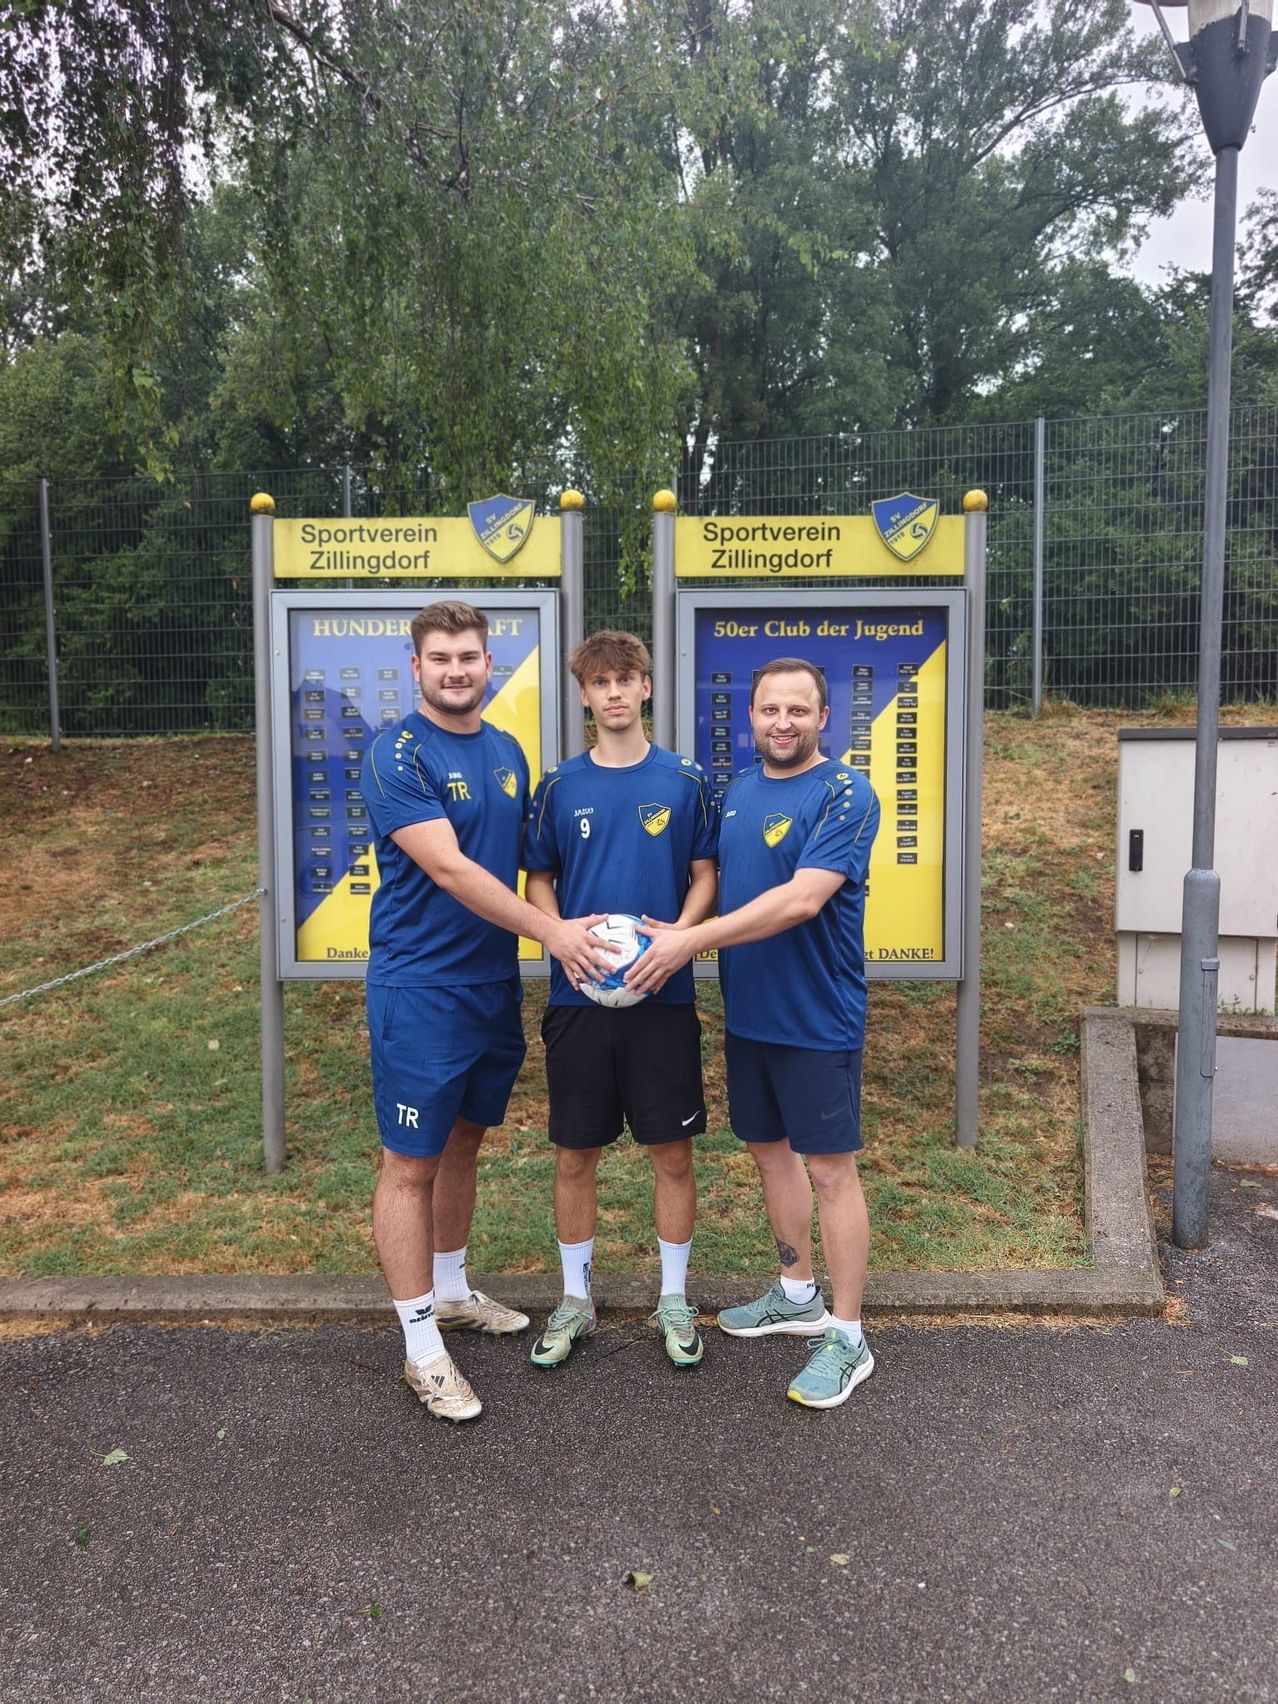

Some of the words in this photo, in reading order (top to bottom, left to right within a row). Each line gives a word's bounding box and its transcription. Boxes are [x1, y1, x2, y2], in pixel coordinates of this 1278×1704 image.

[486, 513, 497, 525] SV
[883, 502, 927, 538] ZILLINGDORF
[890, 512, 900, 523] SV
[301, 523, 437, 547] Sportverein
[703, 521, 840, 546] Sportverein
[310, 550, 430, 574] Zillingdorf
[711, 548, 833, 573] Zillingdorf
[714, 621, 758, 637] 50er
[764, 620, 810, 637] Club
[816, 620, 849, 636] der
[854, 619, 924, 641] Jugend
[447, 782, 471, 801] TR
[581, 818, 591, 839] 9
[326, 947, 369, 959] Danke
[878, 948, 934, 960] DANKE!
[396, 1103, 419, 1129] TR
